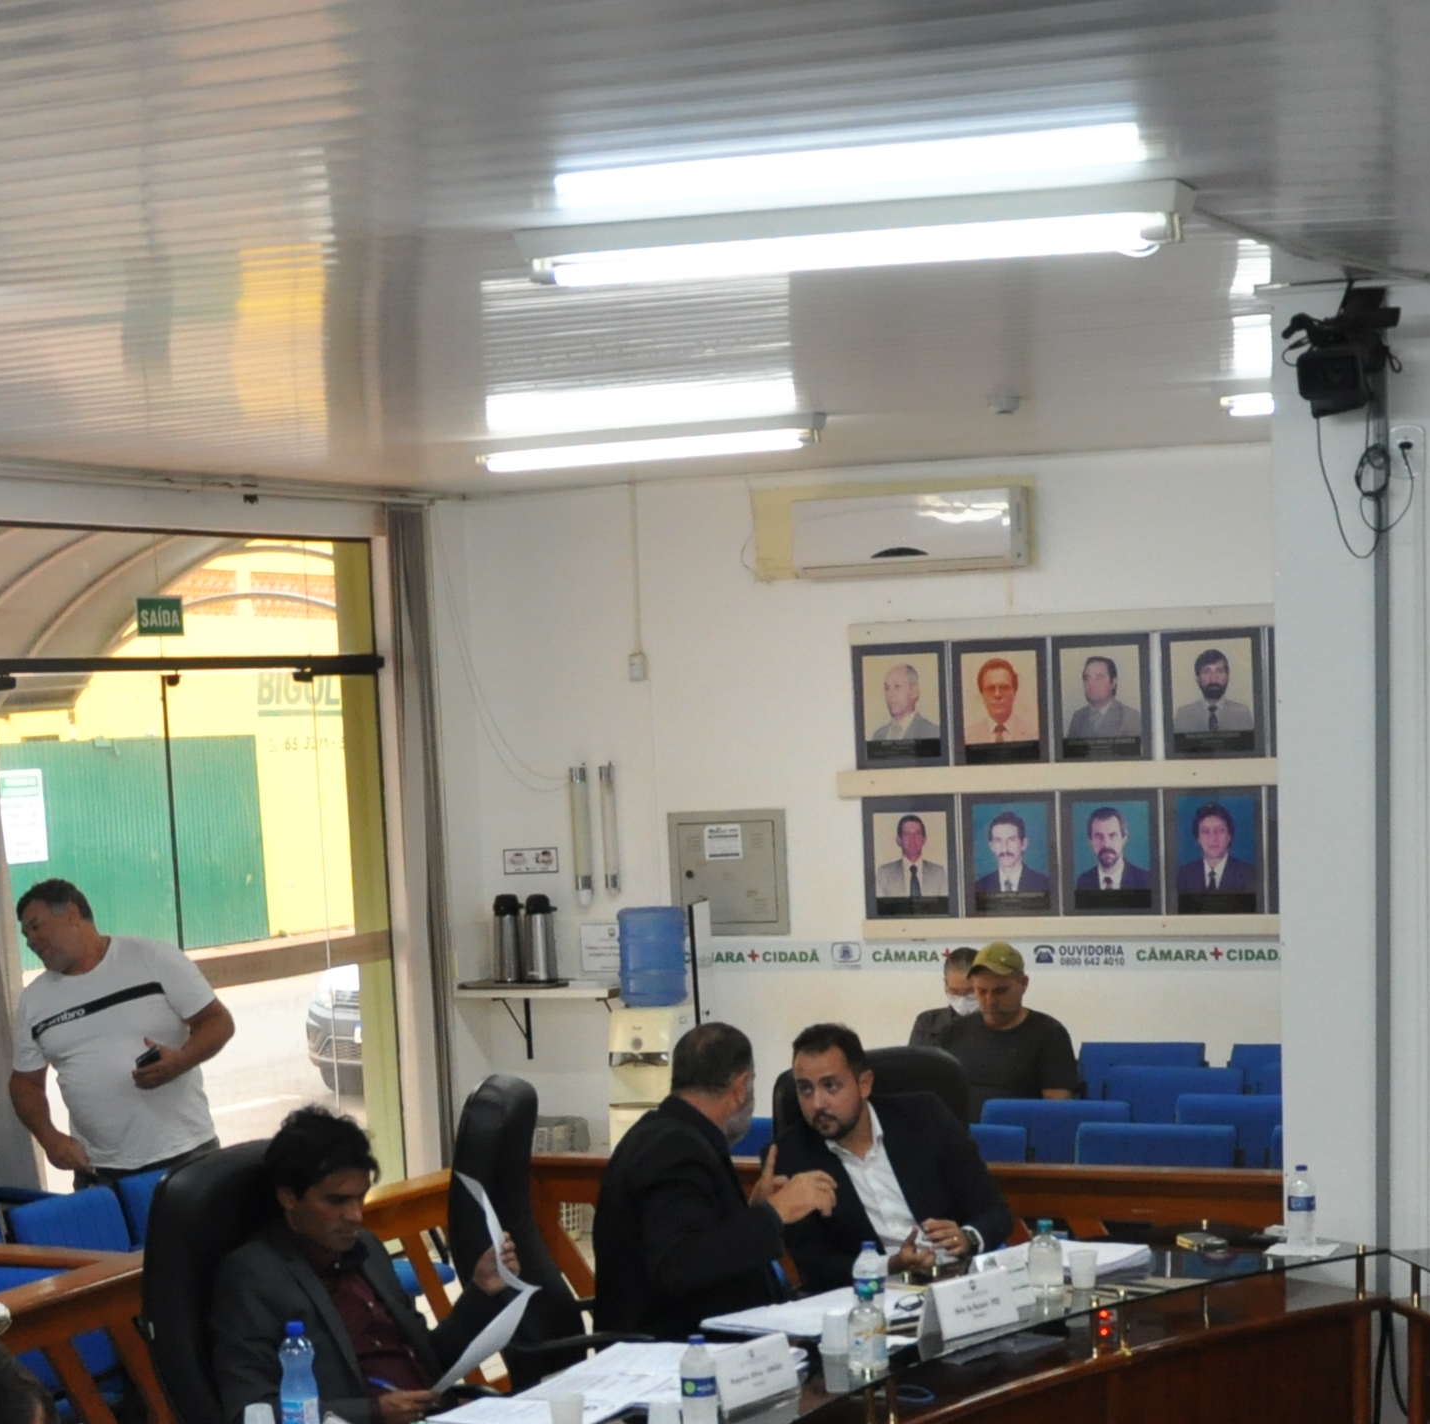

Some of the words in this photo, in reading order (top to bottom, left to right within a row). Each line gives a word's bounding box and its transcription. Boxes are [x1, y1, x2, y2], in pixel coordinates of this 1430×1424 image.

[140, 605, 180, 628] SAÍDA
[762, 949, 820, 963] CIDADÃ
[872, 948, 940, 963] CÂMARA
[1059, 945, 1124, 956] OUVIDORIA
[1136, 947, 1208, 962] CÂMARA
[1226, 948, 1280, 962] CIDAD
[1060, 957, 1082, 966] 0800
[1084, 957, 1101, 966] 642
